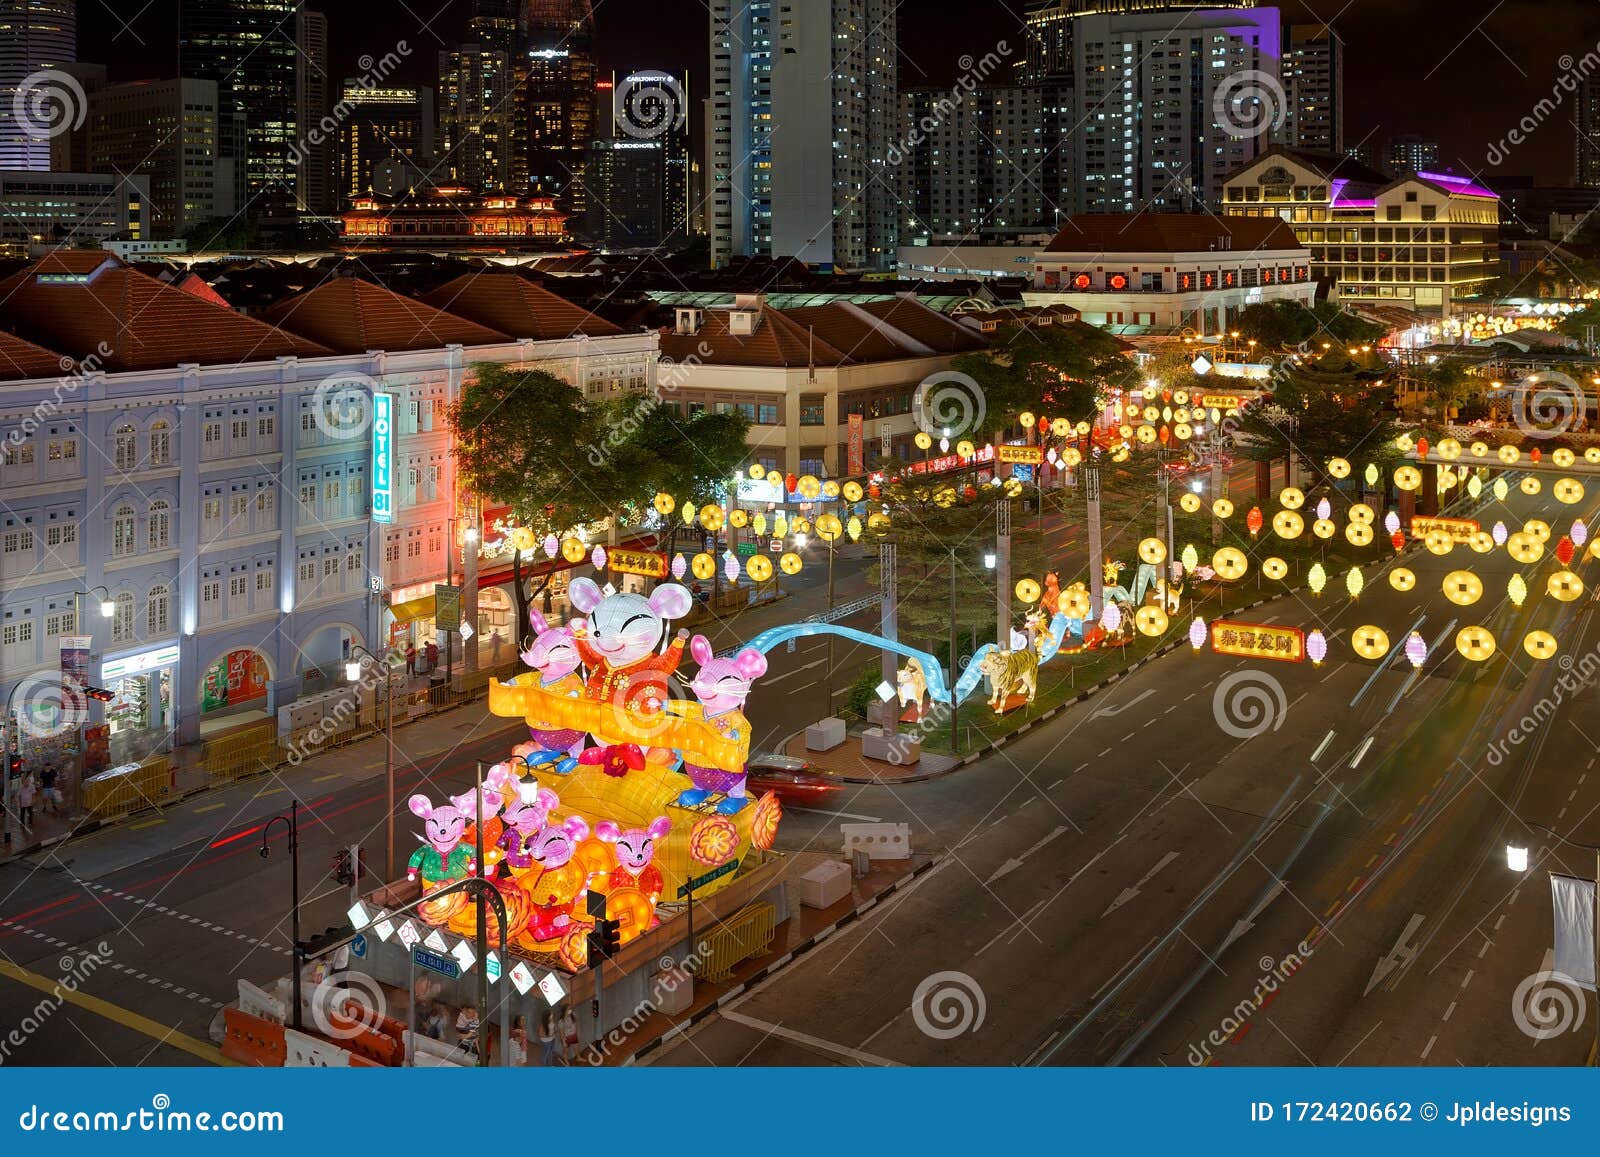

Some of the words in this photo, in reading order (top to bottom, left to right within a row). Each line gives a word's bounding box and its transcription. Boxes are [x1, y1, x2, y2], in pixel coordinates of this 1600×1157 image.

[375, 400, 389, 486] HOTEL
[373, 492, 390, 512] 81
[1221, 629, 1293, 653] 恭喜发财
